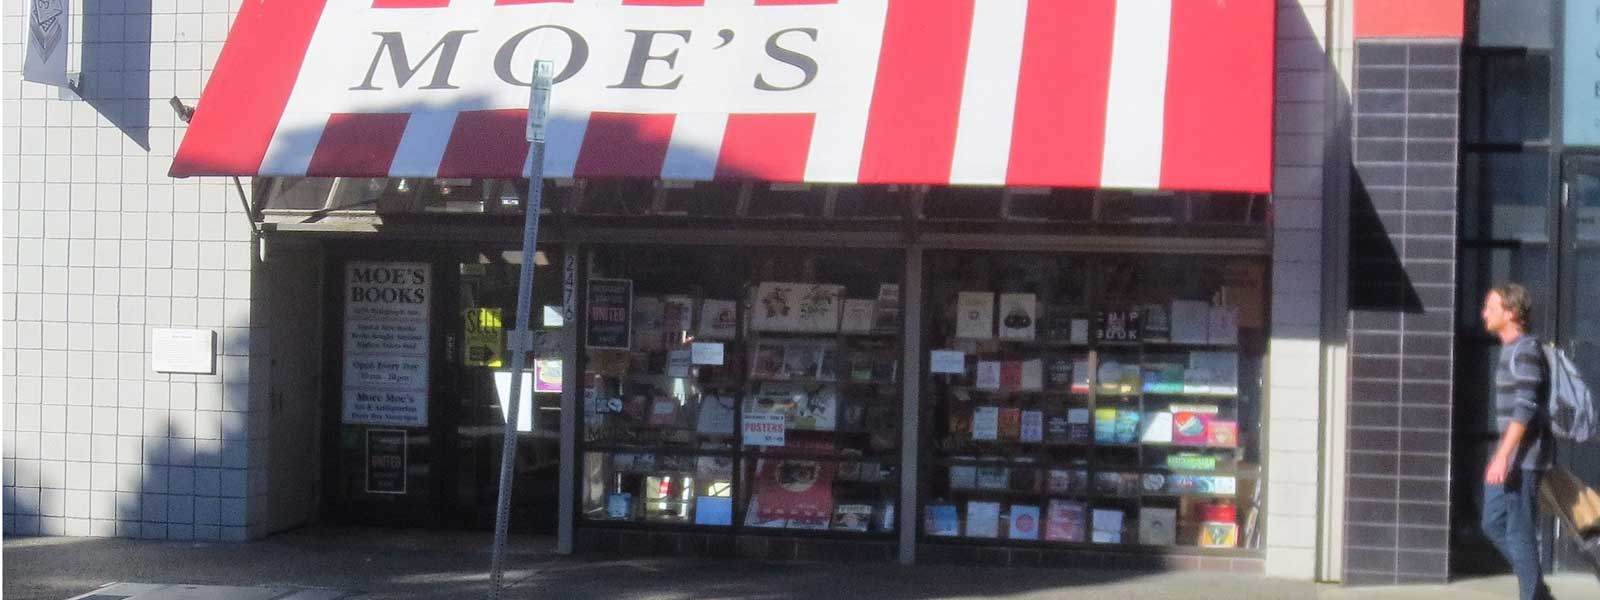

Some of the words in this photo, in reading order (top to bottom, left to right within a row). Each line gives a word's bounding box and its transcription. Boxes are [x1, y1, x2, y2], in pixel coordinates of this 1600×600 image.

[348, 24, 819, 91] MOE'S
[351, 268, 425, 284] MOE'S
[351, 287, 425, 303] BOOKS
[592, 306, 625, 321] UNITED
[745, 423, 784, 432] POSTERS
